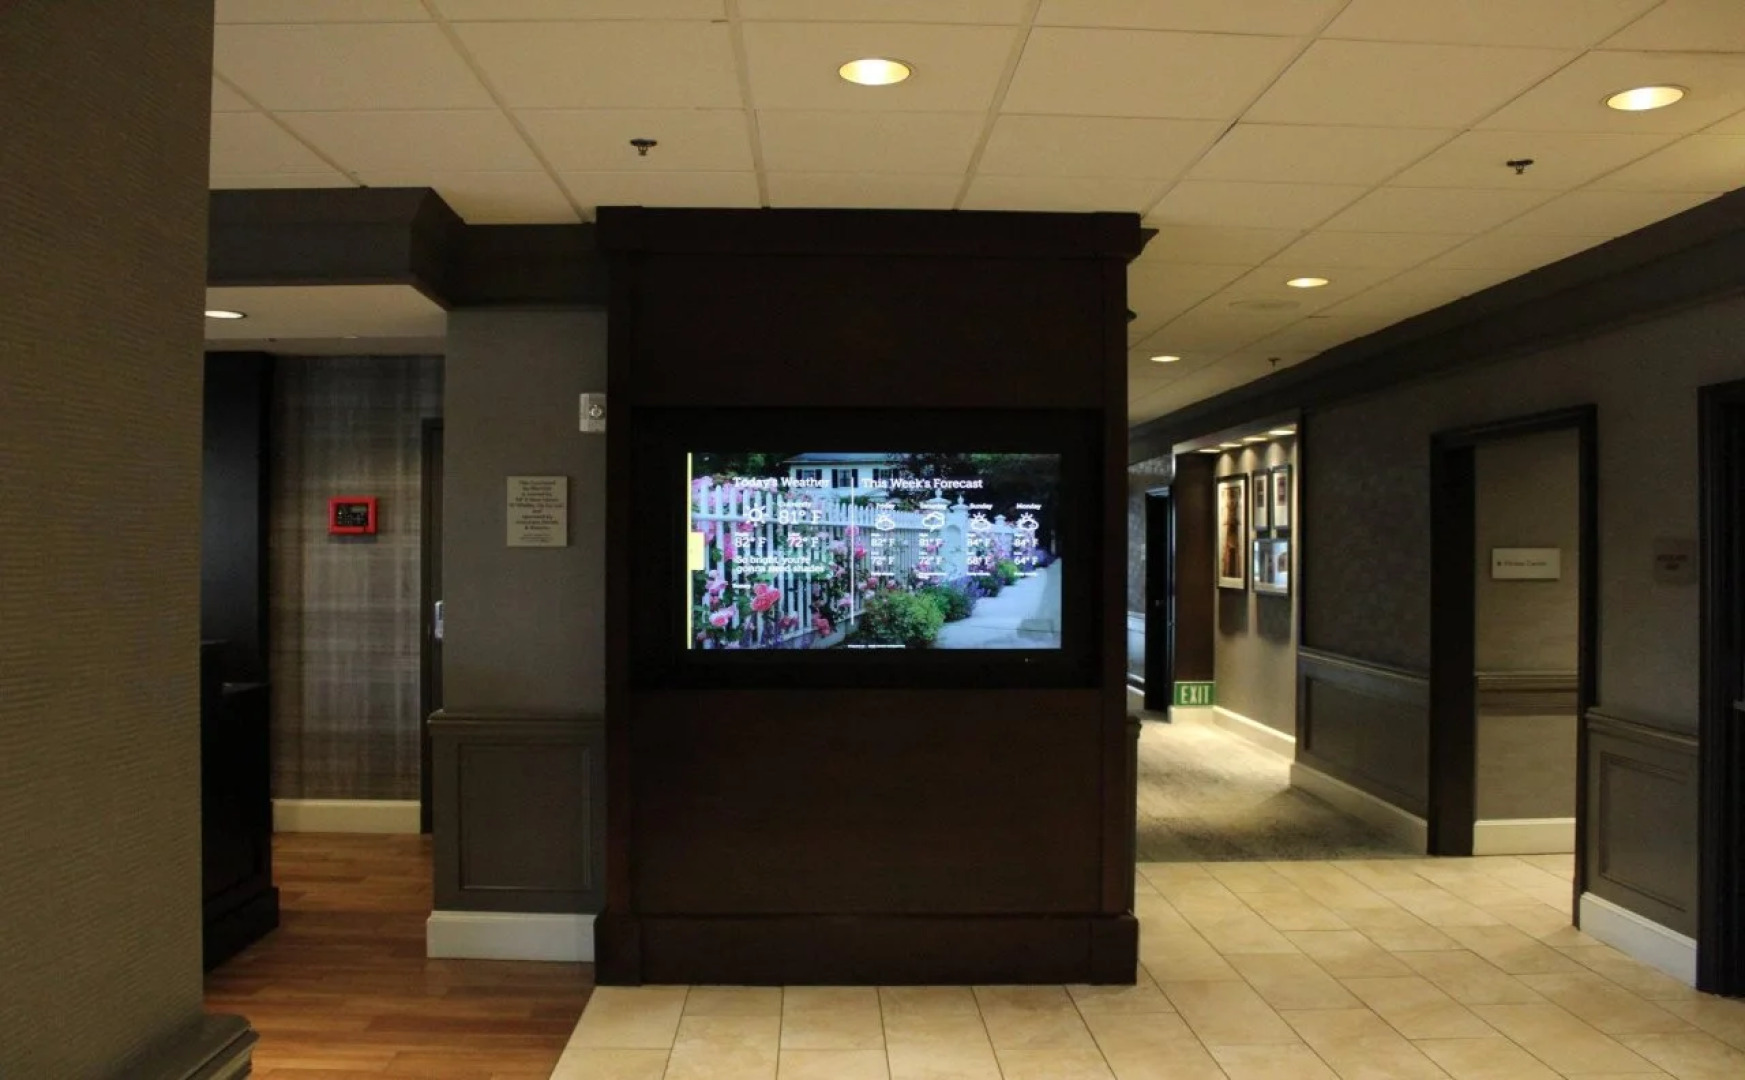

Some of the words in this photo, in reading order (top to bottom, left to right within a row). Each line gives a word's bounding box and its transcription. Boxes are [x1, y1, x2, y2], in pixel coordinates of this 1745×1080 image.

[733, 478, 778, 489] Today's
[781, 477, 830, 488] Weather
[862, 478, 887, 489] This
[890, 478, 932, 489] Week's
[934, 478, 983, 489] Forecast
[1181, 685, 1210, 705] EXIT
